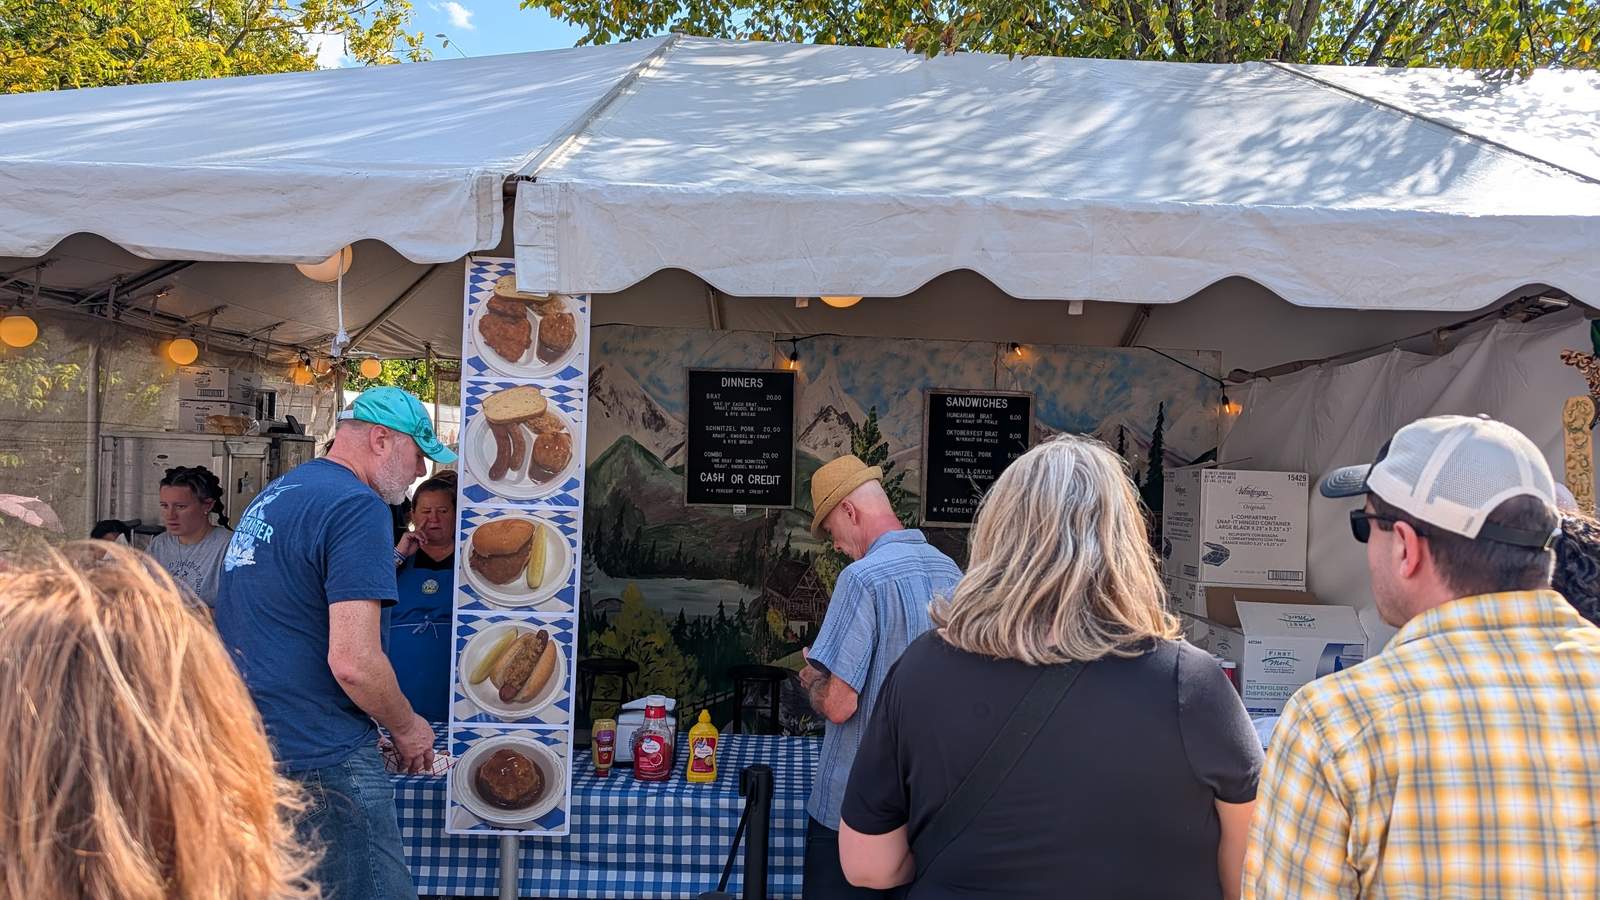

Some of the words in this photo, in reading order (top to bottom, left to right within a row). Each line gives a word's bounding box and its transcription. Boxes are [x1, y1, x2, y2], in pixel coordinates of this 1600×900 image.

[721, 377, 763, 388] DINNERS
[946, 397, 1008, 408] SANDWICHES
[731, 474, 743, 484] OR
[748, 474, 781, 485] CREDIT
[1288, 474, 1307, 482] 15429
